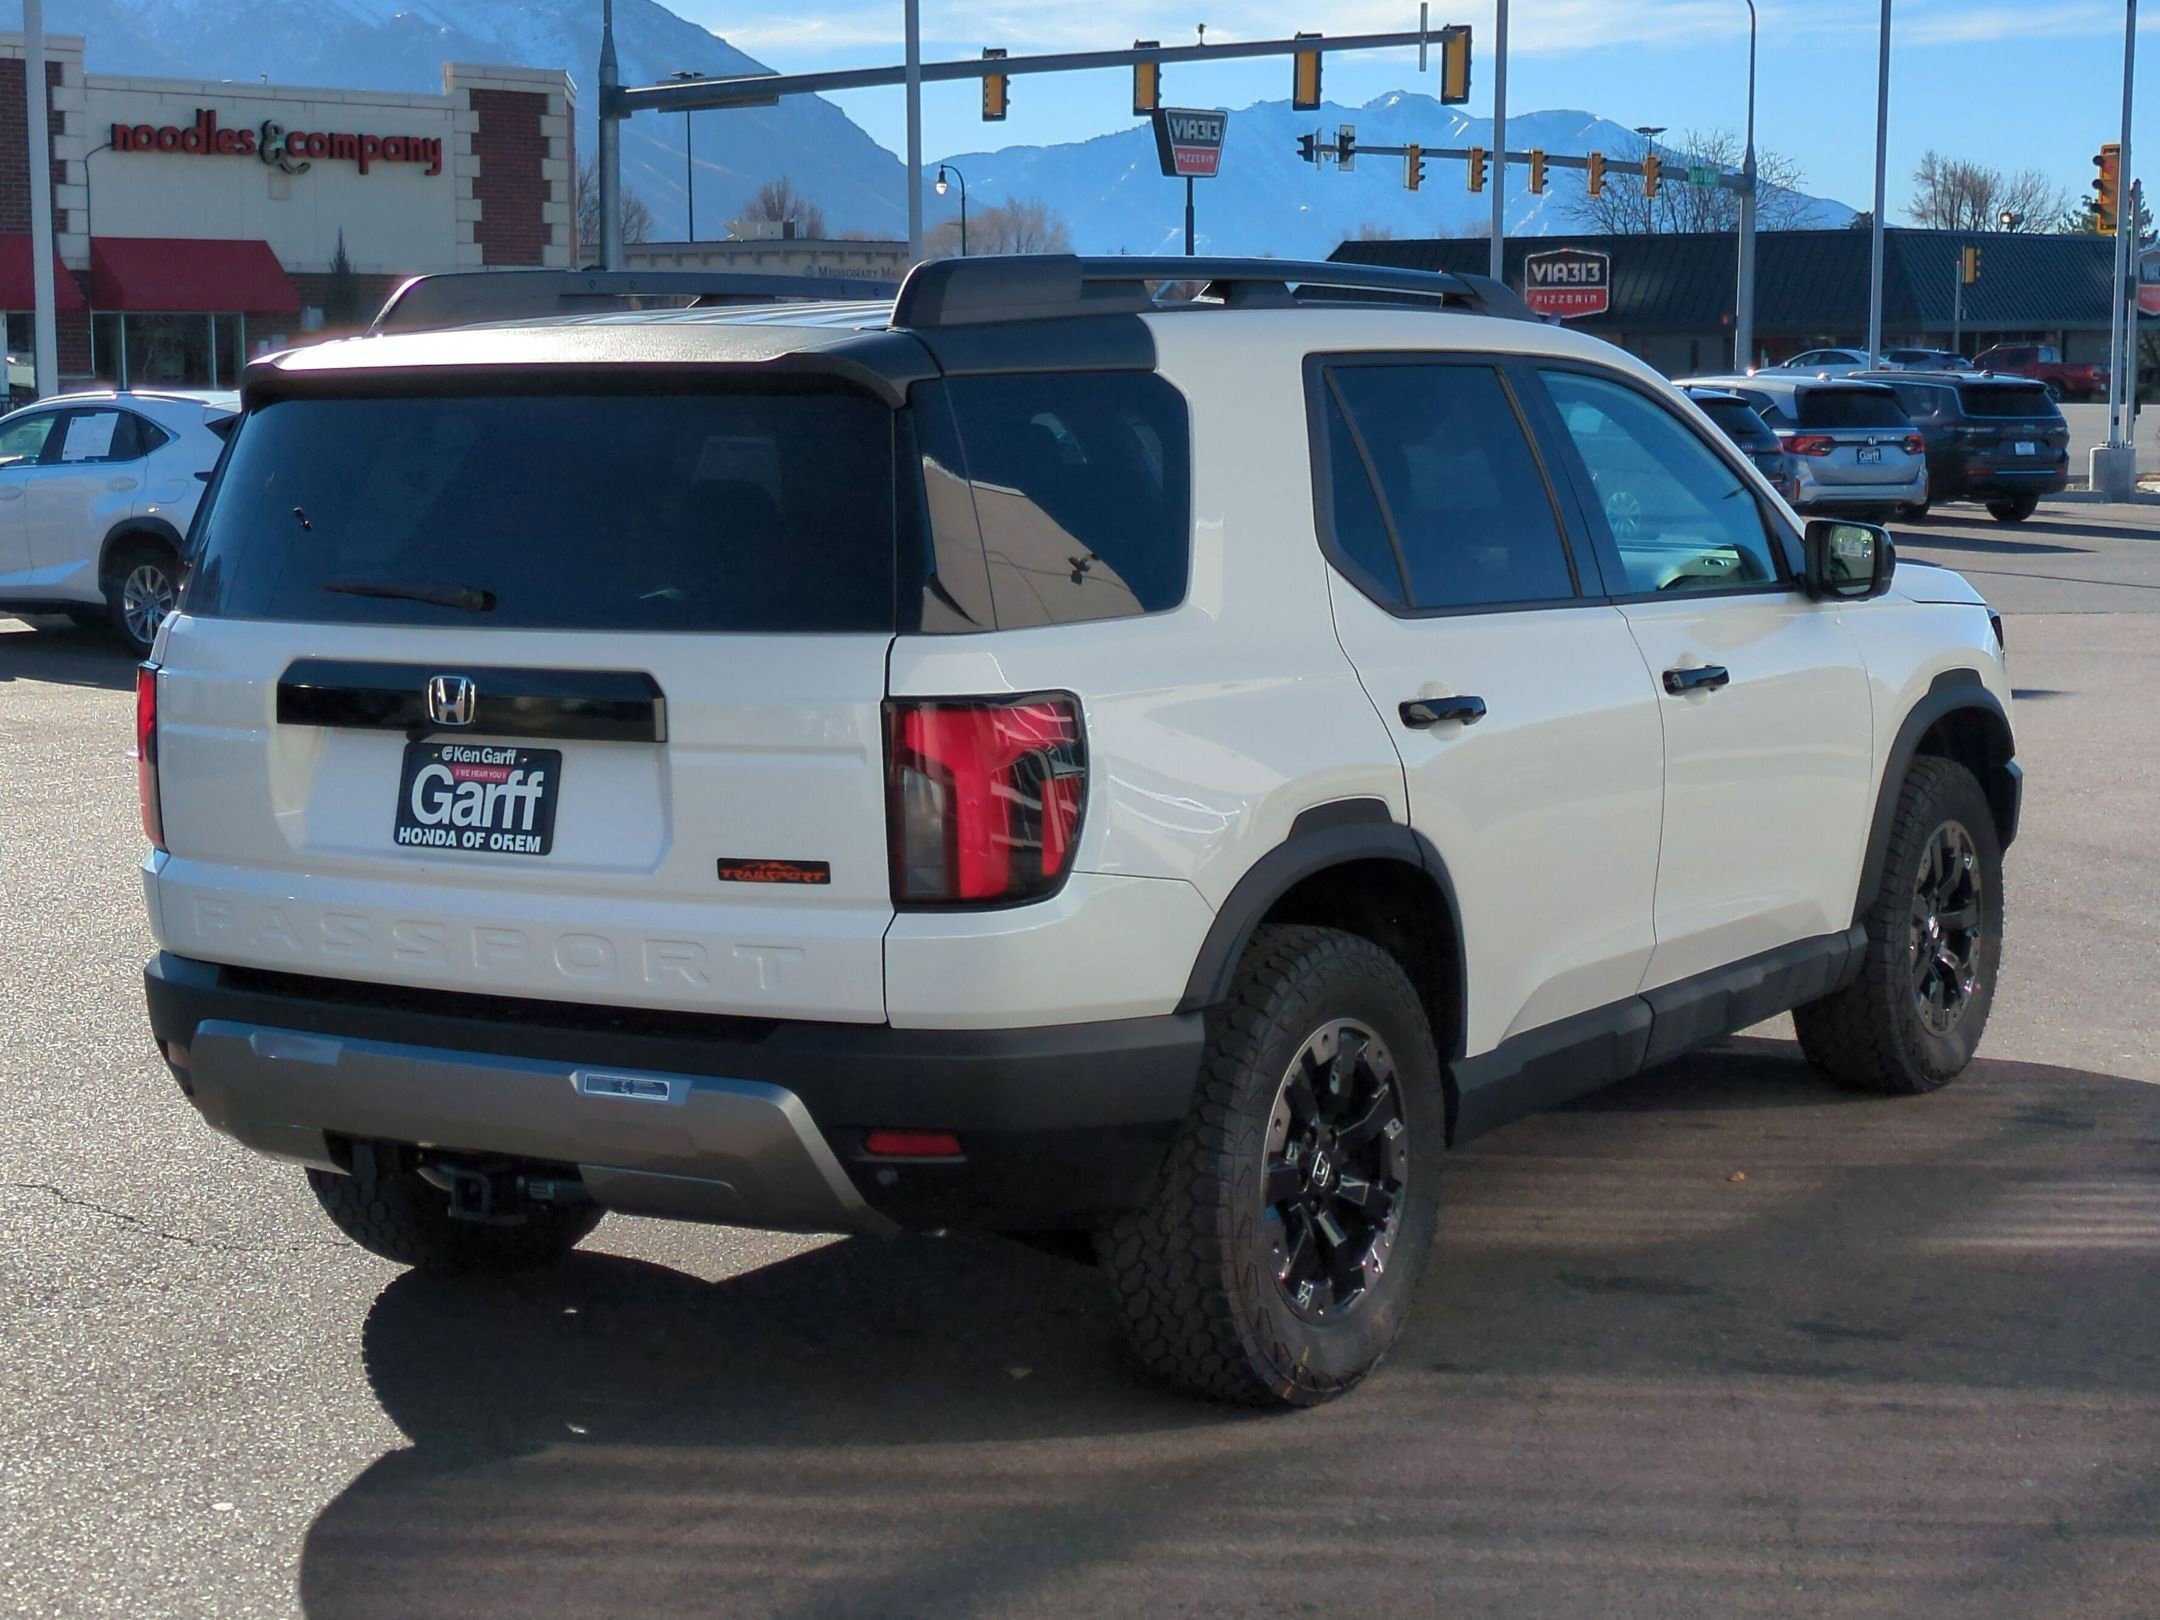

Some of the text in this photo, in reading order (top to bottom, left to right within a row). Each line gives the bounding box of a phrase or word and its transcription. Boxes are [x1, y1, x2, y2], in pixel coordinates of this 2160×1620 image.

[111, 109, 256, 156] noodles
[285, 131, 443, 176] company
[1535, 294, 1598, 305] PIZZERIA
[453, 746, 517, 765] Ken Garff
[411, 763, 544, 831] Garff
[398, 826, 542, 853] HONDA OF OREM
[194, 900, 805, 992] PASSPORT
